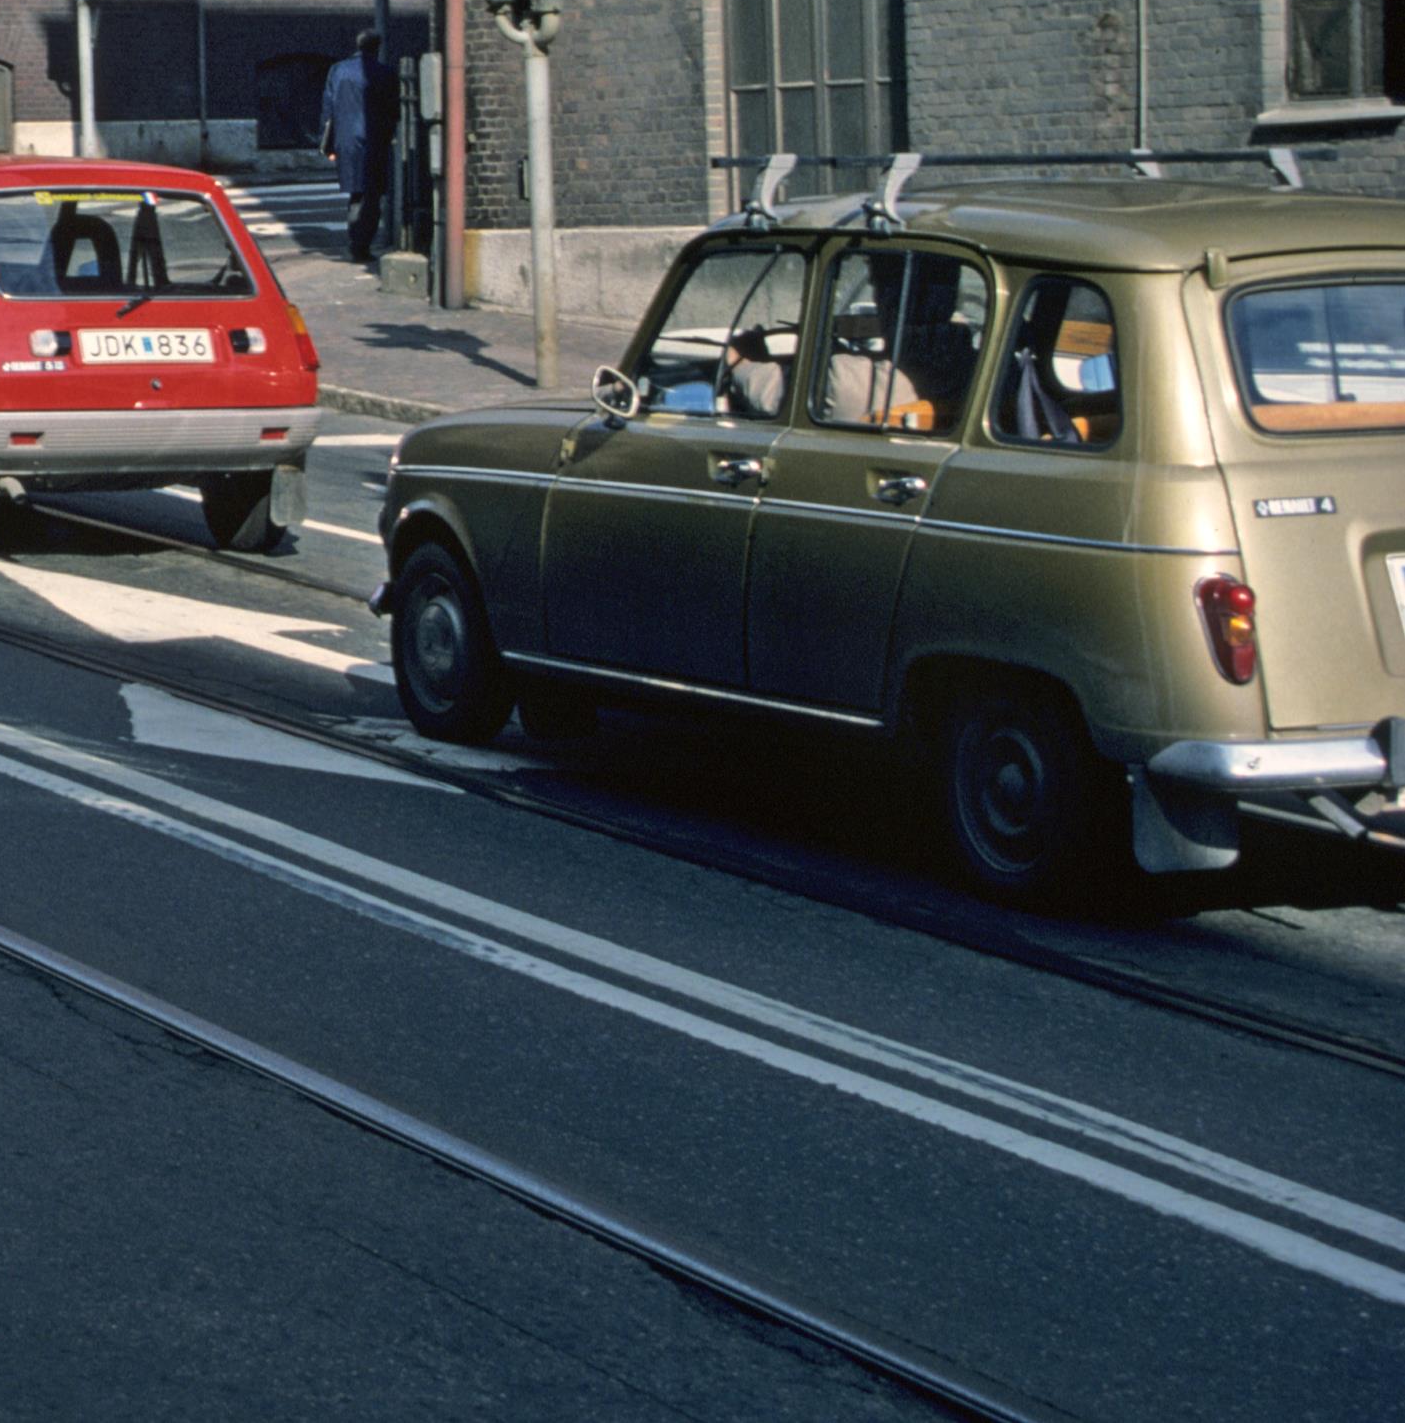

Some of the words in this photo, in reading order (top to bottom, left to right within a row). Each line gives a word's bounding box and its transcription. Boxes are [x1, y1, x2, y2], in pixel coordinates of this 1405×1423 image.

[90, 335, 138, 357] JDK
[157, 334, 208, 357] 836
[1321, 496, 1333, 512] 4
